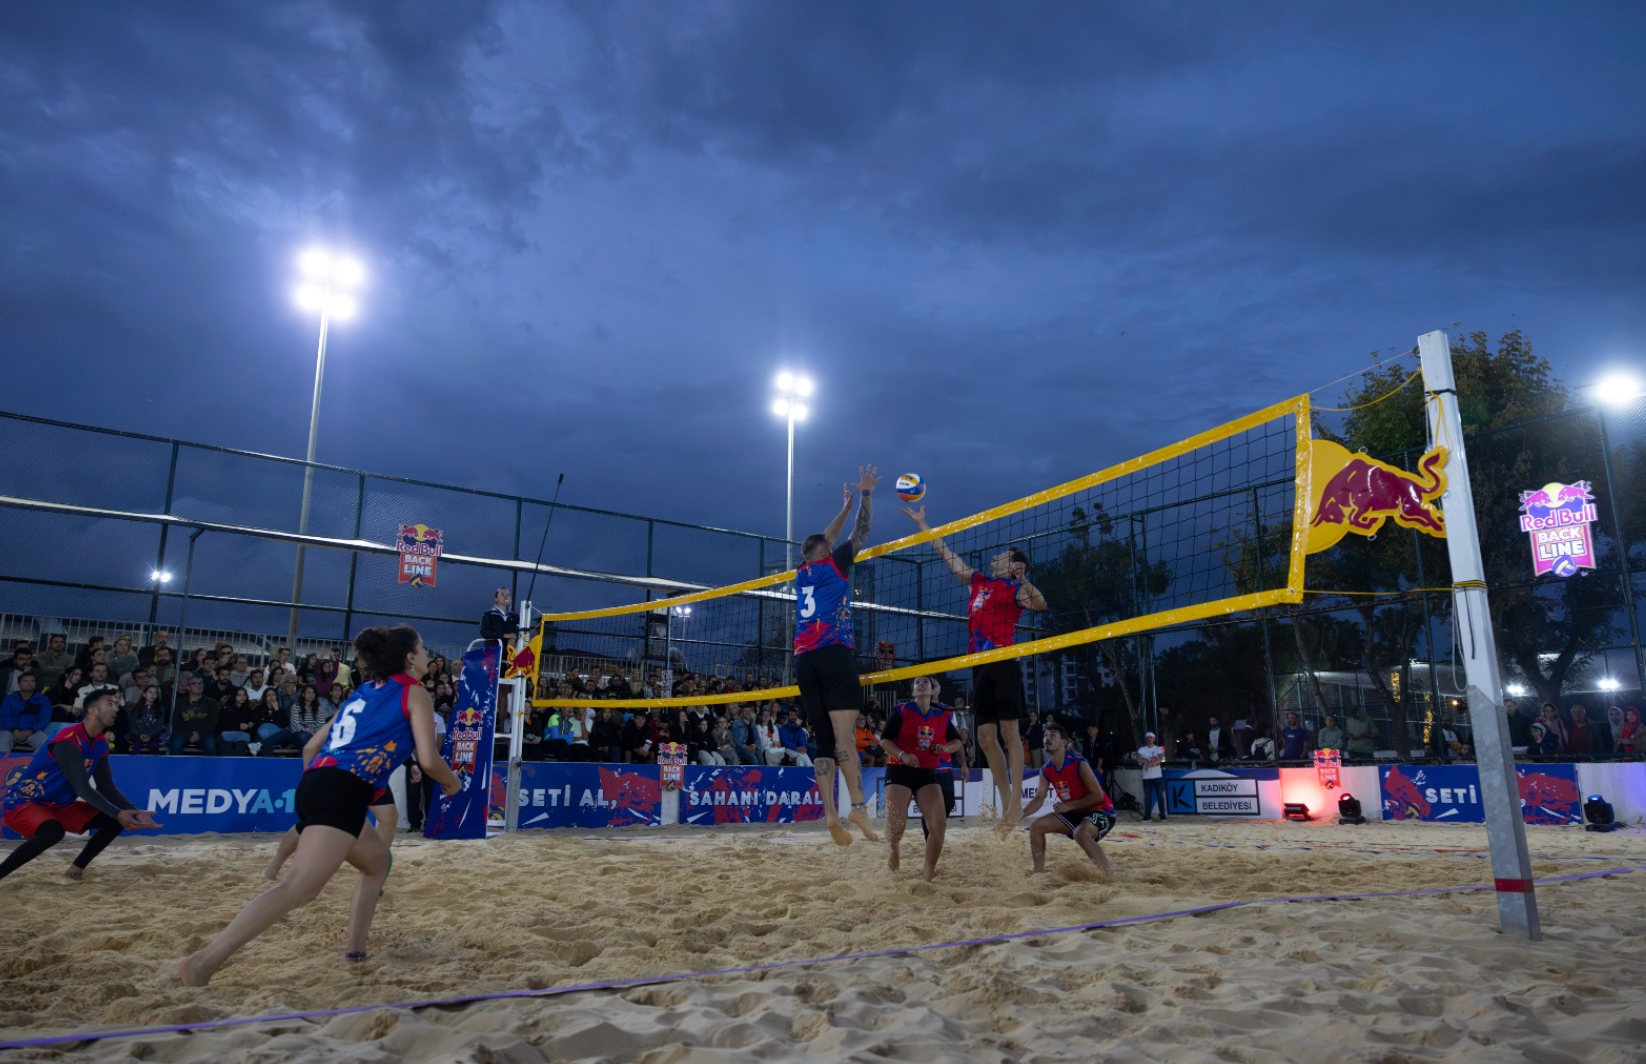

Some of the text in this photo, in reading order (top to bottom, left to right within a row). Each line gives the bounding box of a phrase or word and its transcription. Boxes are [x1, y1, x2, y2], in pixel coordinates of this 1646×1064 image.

[1520, 503, 1598, 532] Red Bull
[1538, 527, 1582, 543] BACK
[396, 540, 443, 556] Red Bull
[1540, 540, 1584, 559] LINE
[405, 555, 432, 565] BACK
[404, 564, 432, 576] LINE
[801, 586, 816, 618] 3
[330, 698, 367, 752] 6
[454, 727, 483, 740] Red Bull
[457, 742, 475, 751] BACK
[455, 751, 474, 762] LINE
[664, 765, 681, 773] BACK
[1201, 783, 1238, 792] KADIKÖY
[1425, 785, 1477, 804] SETİ
[519, 784, 617, 809] SETİ AL,
[689, 791, 758, 806] SAHANI
[1202, 800, 1252, 810] BELEDİYESİ
